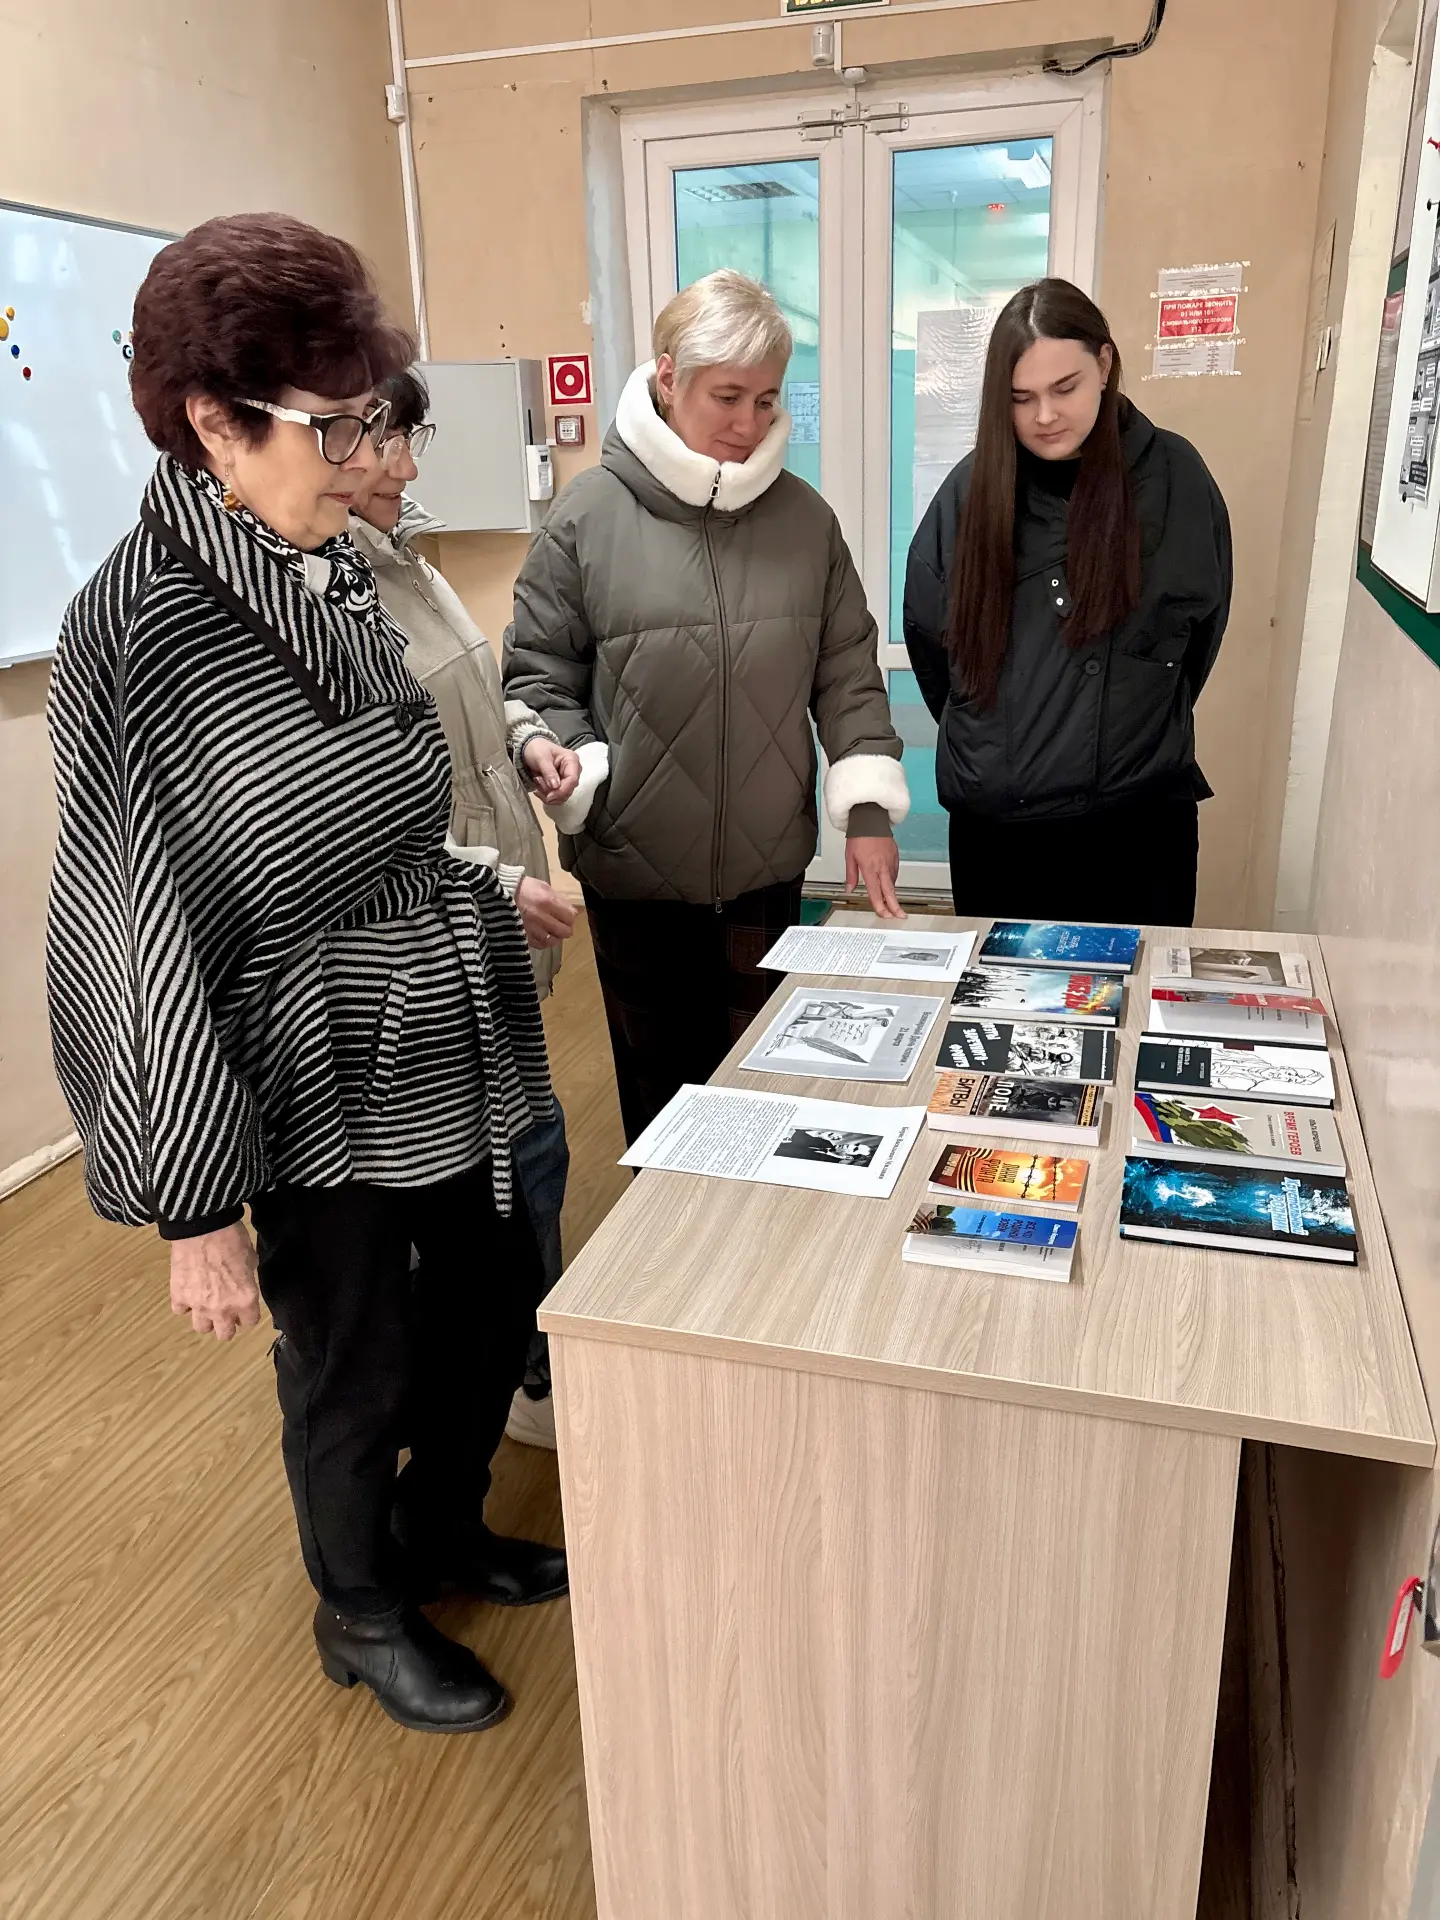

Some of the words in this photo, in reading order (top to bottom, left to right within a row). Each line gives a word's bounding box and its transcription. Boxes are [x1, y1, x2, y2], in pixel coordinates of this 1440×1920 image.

[948, 1077, 975, 1108] БИТВЫ
[988, 1080, 1015, 1111] ПОЛЕ
[1283, 1111, 1298, 1131] ВРЕМЯ
[1286, 1130, 1302, 1156] ГЕРОЕВ
